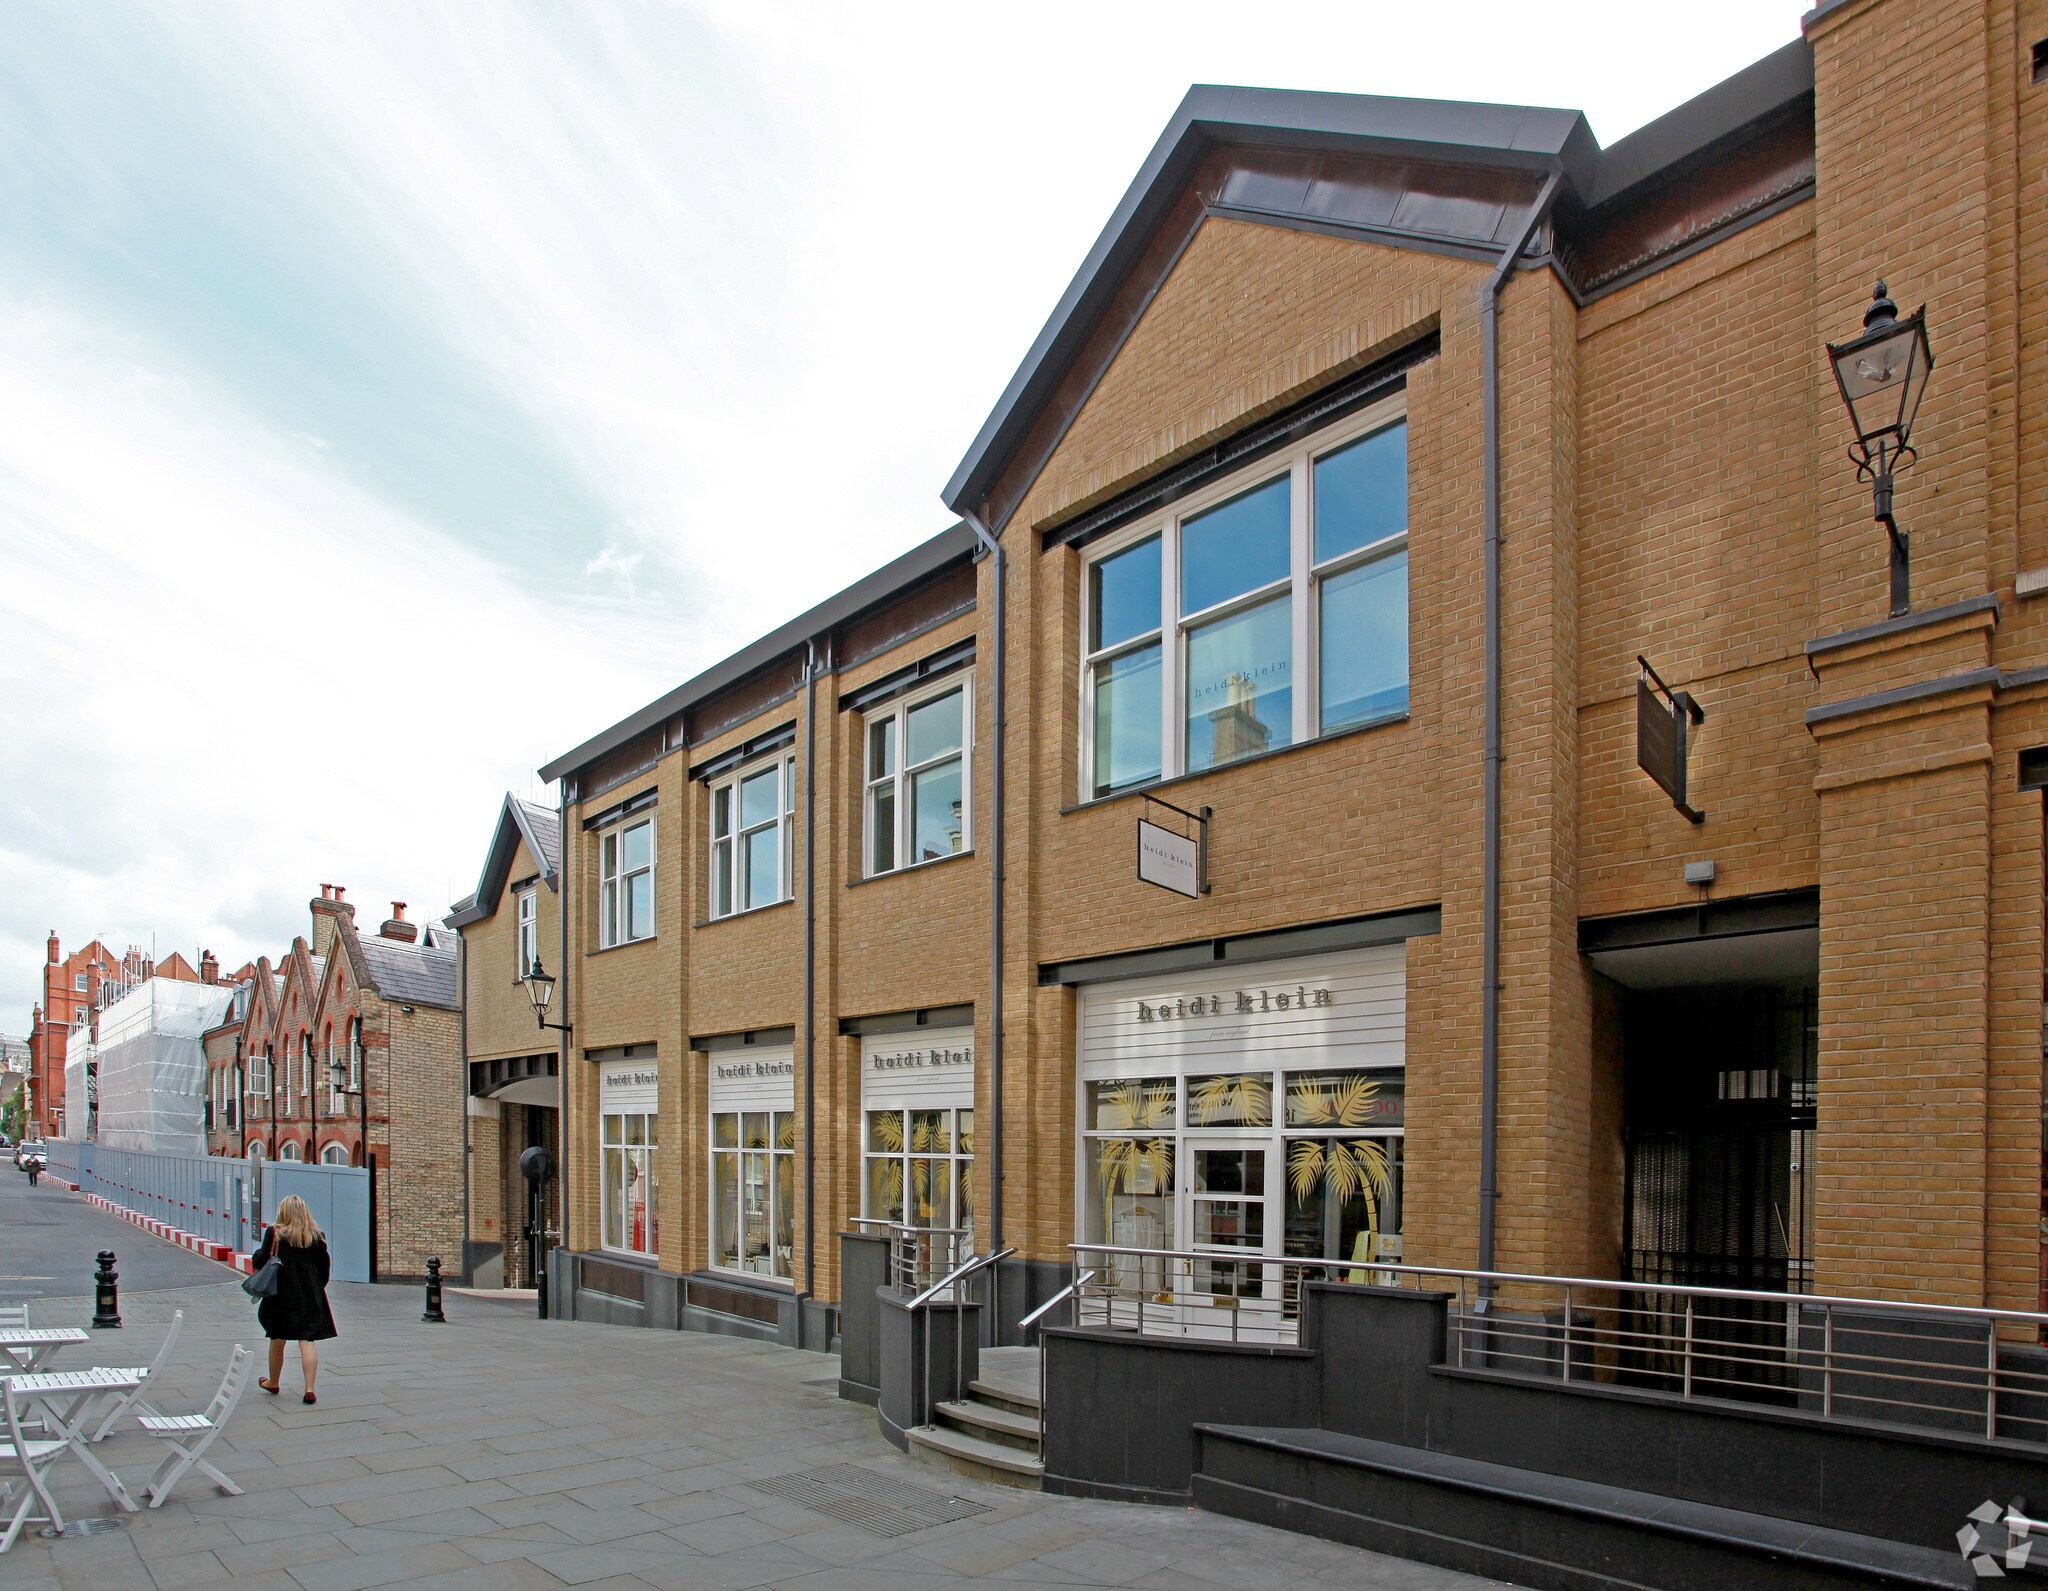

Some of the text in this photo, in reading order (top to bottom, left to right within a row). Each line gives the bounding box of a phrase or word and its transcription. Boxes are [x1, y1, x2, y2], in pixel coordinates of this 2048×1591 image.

[1194, 661, 1287, 698] heidi klein
[1144, 843, 1193, 868] heidi klein
[1137, 986, 1331, 1021] heidi klein
[717, 1061, 793, 1078] heidi klein
[873, 1047, 974, 1069] heidi klei
[606, 1074, 632, 1086] heidi
